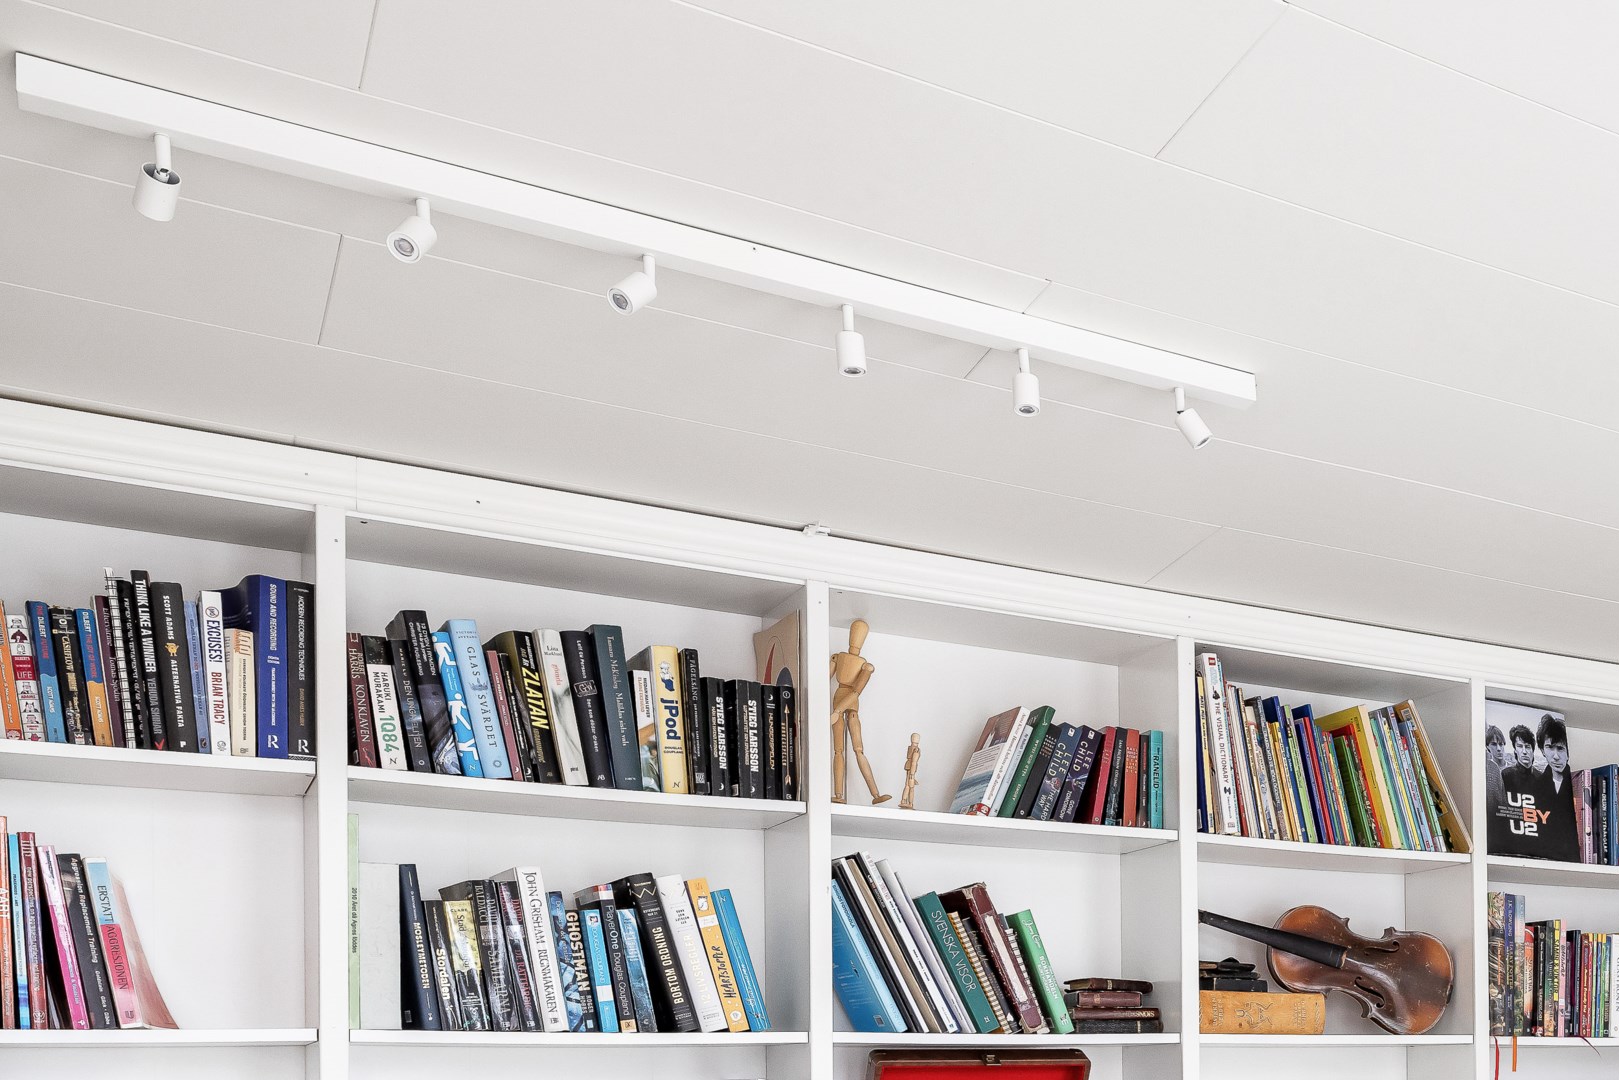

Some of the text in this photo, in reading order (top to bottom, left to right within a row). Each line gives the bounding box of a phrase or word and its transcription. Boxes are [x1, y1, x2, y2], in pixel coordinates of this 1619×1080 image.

[135, 579, 147, 607] THINK
[269, 583, 277, 603] SOUND
[269, 604, 277, 617] AND
[138, 607, 149, 627] LIKE
[142, 637, 156, 672] WINNER
[162, 595, 185, 727] SCOTT ADAMS ALTERNATIVA FAKTA
[206, 620, 225, 725] EXCUSES! BRIAN TRACY
[348, 648, 365, 679] ROBERT HARRIS
[146, 677, 158, 706] YEHUDA
[372, 671, 384, 713] MURAKAMI
[381, 671, 391, 701] HARUKI
[521, 667, 550, 730] ZLATAN
[354, 684, 370, 742] KONKLAVEN
[660, 698, 681, 740] jPod
[379, 715, 399, 753] 1Q84
[715, 696, 727, 769] STIEG LARSSON
[748, 700, 759, 772] STIEG LARSSON
[1214, 702, 1229, 784] THE VISUAL DICTIONARY
[1048, 742, 1066, 777] CHILD
[1058, 752, 1073, 774] LEE
[1073, 740, 1089, 771] CHILD
[1082, 750, 1094, 768] LEE
[1038, 793, 1048, 808] WAY
[1040, 788, 1060, 821] THE HARD
[1058, 790, 1072, 820] TOMORROW
[1066, 799, 1076, 815] GONE
[1506, 792, 1536, 809] U2
[1523, 806, 1551, 825] BY
[1509, 819, 1539, 837] U2
[475, 885, 488, 923] BALDACCI
[98, 885, 129, 990] ERSTATT AGGRESJONEN
[456, 915, 466, 932] Stad
[413, 922, 430, 989] MOSLEYMETODEN
[522, 871, 558, 1014] JOHN GRISHAM REGNMAKAREN
[566, 912, 591, 992] GHOSTMAN
[930, 910, 978, 993] SVENSKA VISOR
[435, 948, 452, 1000] Stordalen
[612, 952, 623, 981] Douglas
[618, 982, 631, 1016] Coupland
[652, 927, 684, 1005] BORTOM ORDNING
[711, 946, 737, 998] HEARTSTOPPER
